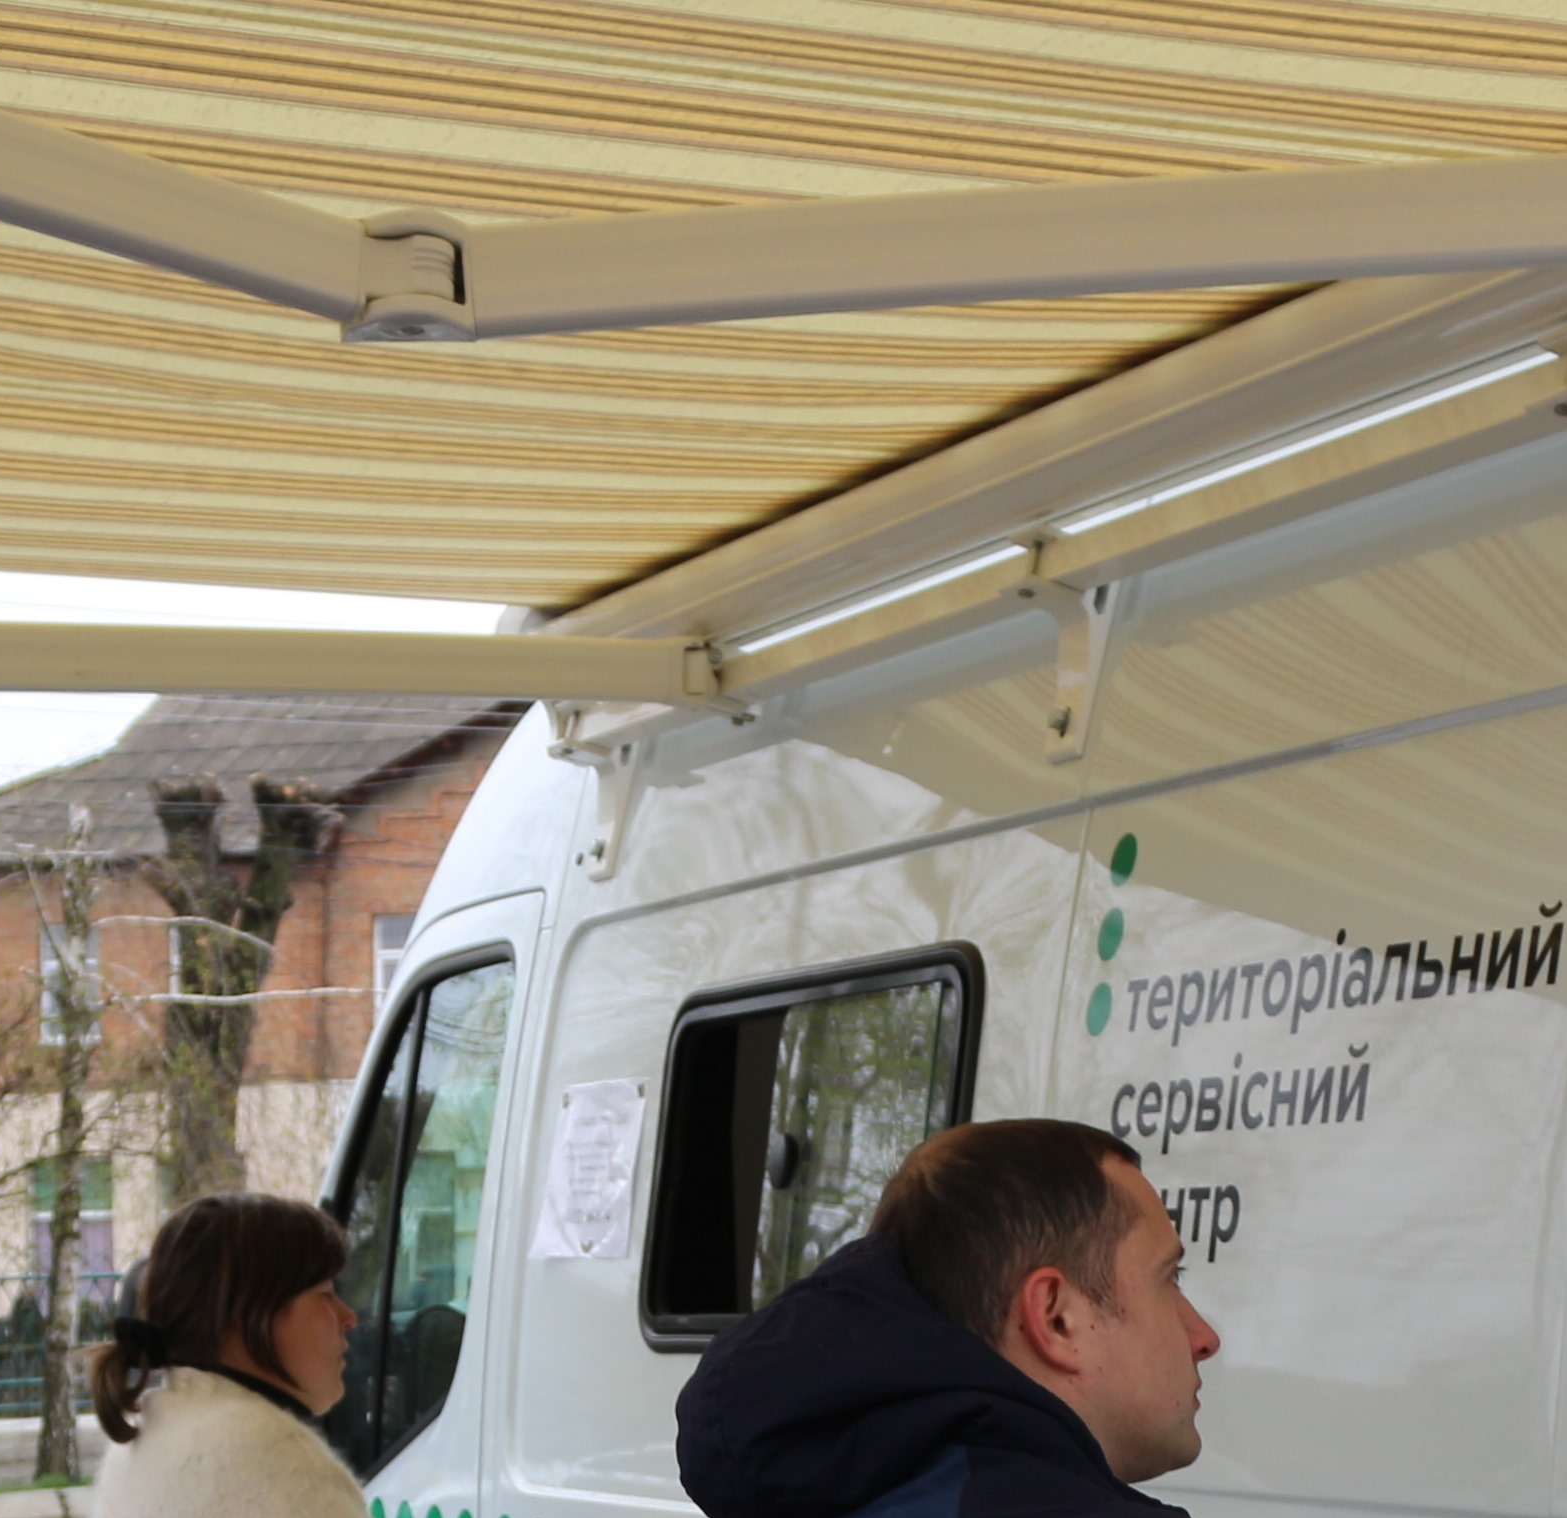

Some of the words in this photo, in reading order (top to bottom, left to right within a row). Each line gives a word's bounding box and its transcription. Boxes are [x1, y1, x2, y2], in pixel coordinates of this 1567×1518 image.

[1126, 901, 1564, 1046] територіальний
[1112, 1043, 1371, 1154] сервісний
[1161, 1184, 1241, 1263] нтр
